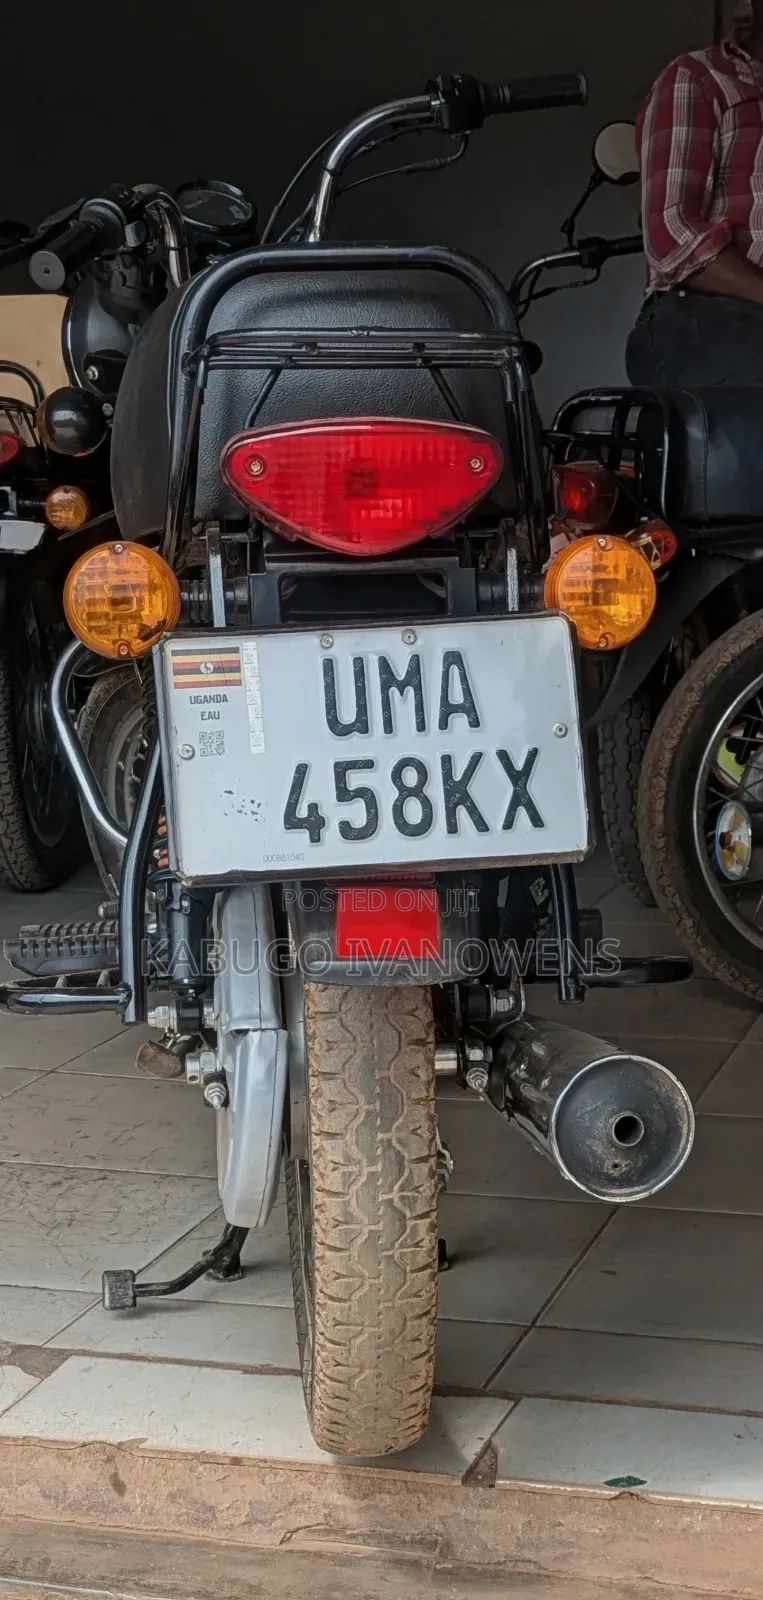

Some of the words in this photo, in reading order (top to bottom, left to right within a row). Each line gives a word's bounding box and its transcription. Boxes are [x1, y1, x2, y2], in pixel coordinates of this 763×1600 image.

[189, 693, 229, 705] UGANDA
[200, 710, 221, 721] EAU
[322, 650, 480, 736] UMA
[283, 747, 545, 844] 458KX
